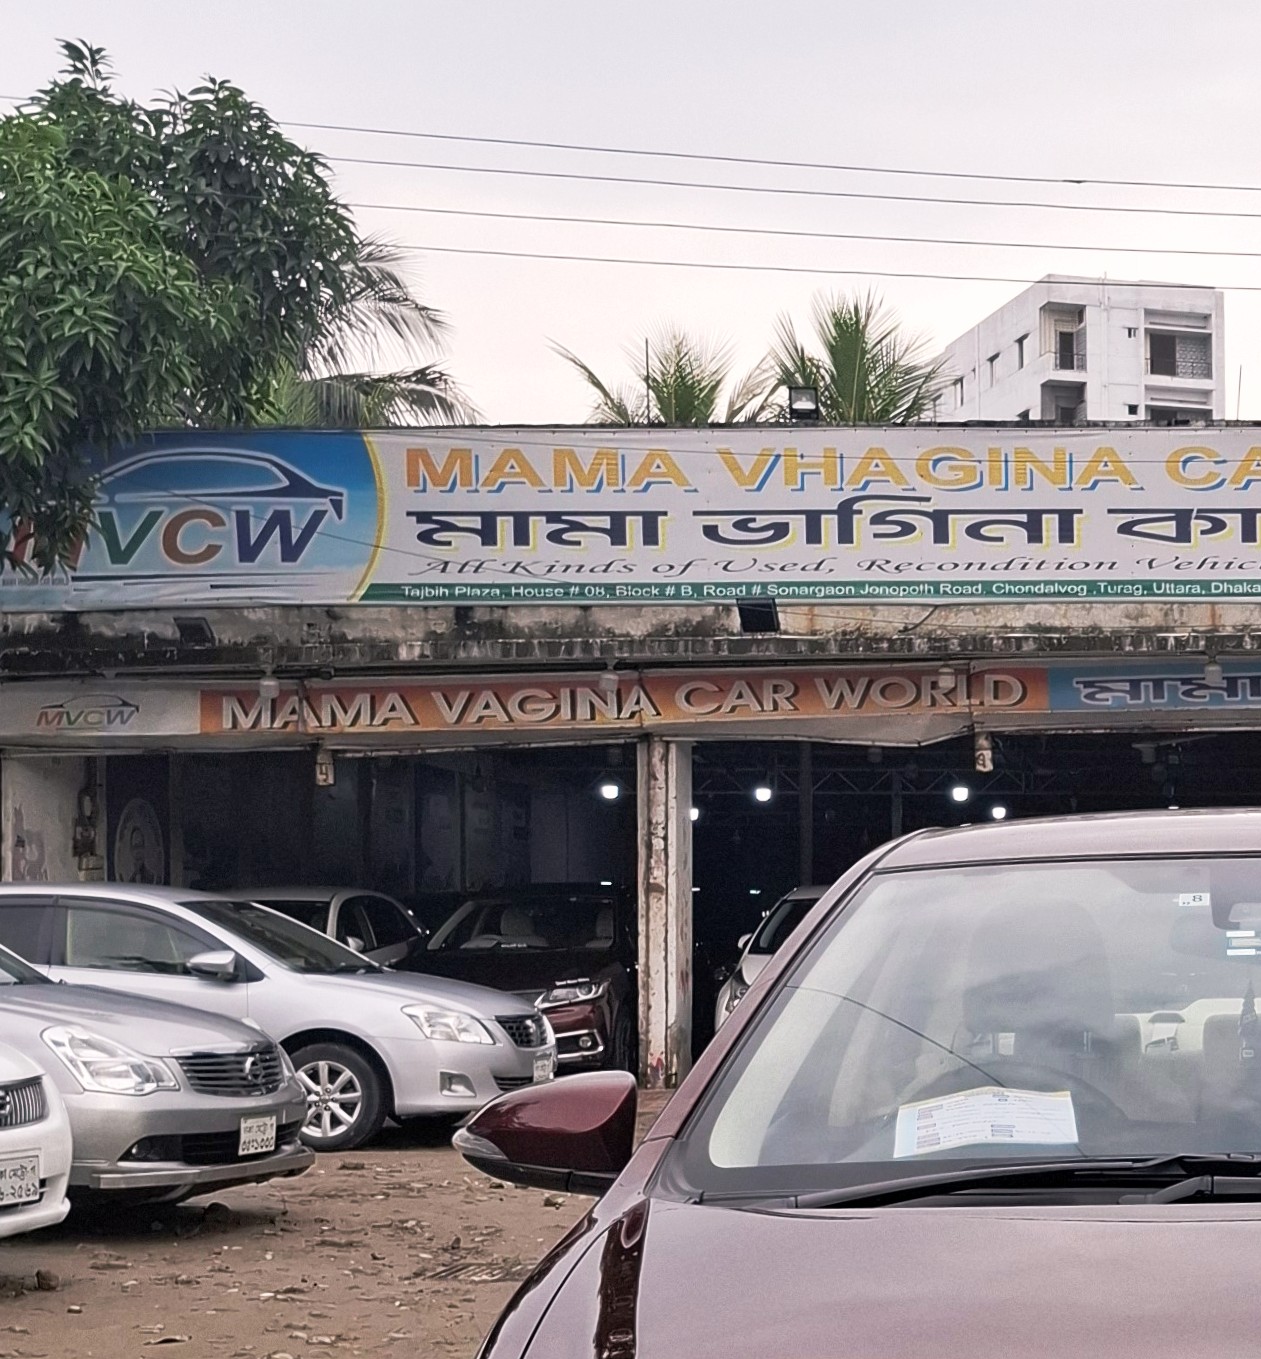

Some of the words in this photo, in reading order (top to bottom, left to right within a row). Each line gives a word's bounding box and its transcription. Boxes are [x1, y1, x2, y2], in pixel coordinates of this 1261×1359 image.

[405, 447, 698, 493] MAMA
[715, 446, 1144, 492] VHAGINA
[405, 509, 668, 547] মামা
[692, 494, 1084, 546] ভাগিনা
[408, 558, 495, 576] All
[498, 557, 638, 577] Kinds
[651, 557, 706, 578] of
[713, 556, 837, 575] Used,
[856, 555, 1119, 575] Recondition
[401, 585, 449, 599] Tajbih
[454, 585, 506, 599] Plaza,
[511, 585, 564, 597] House
[615, 584, 660, 597] Block
[680, 584, 698, 598] B,
[703, 583, 746, 597] Road
[767, 583, 855, 598] Sonargaon
[992, 581, 1088, 597] Chondalvog
[1153, 581, 1206, 595] Uttara,
[36, 708, 137, 728] MVCW
[222, 691, 421, 731] MAMA
[430, 685, 662, 725] VAGINA
[674, 678, 800, 716] CAR
[813, 673, 1028, 710] WORLD
